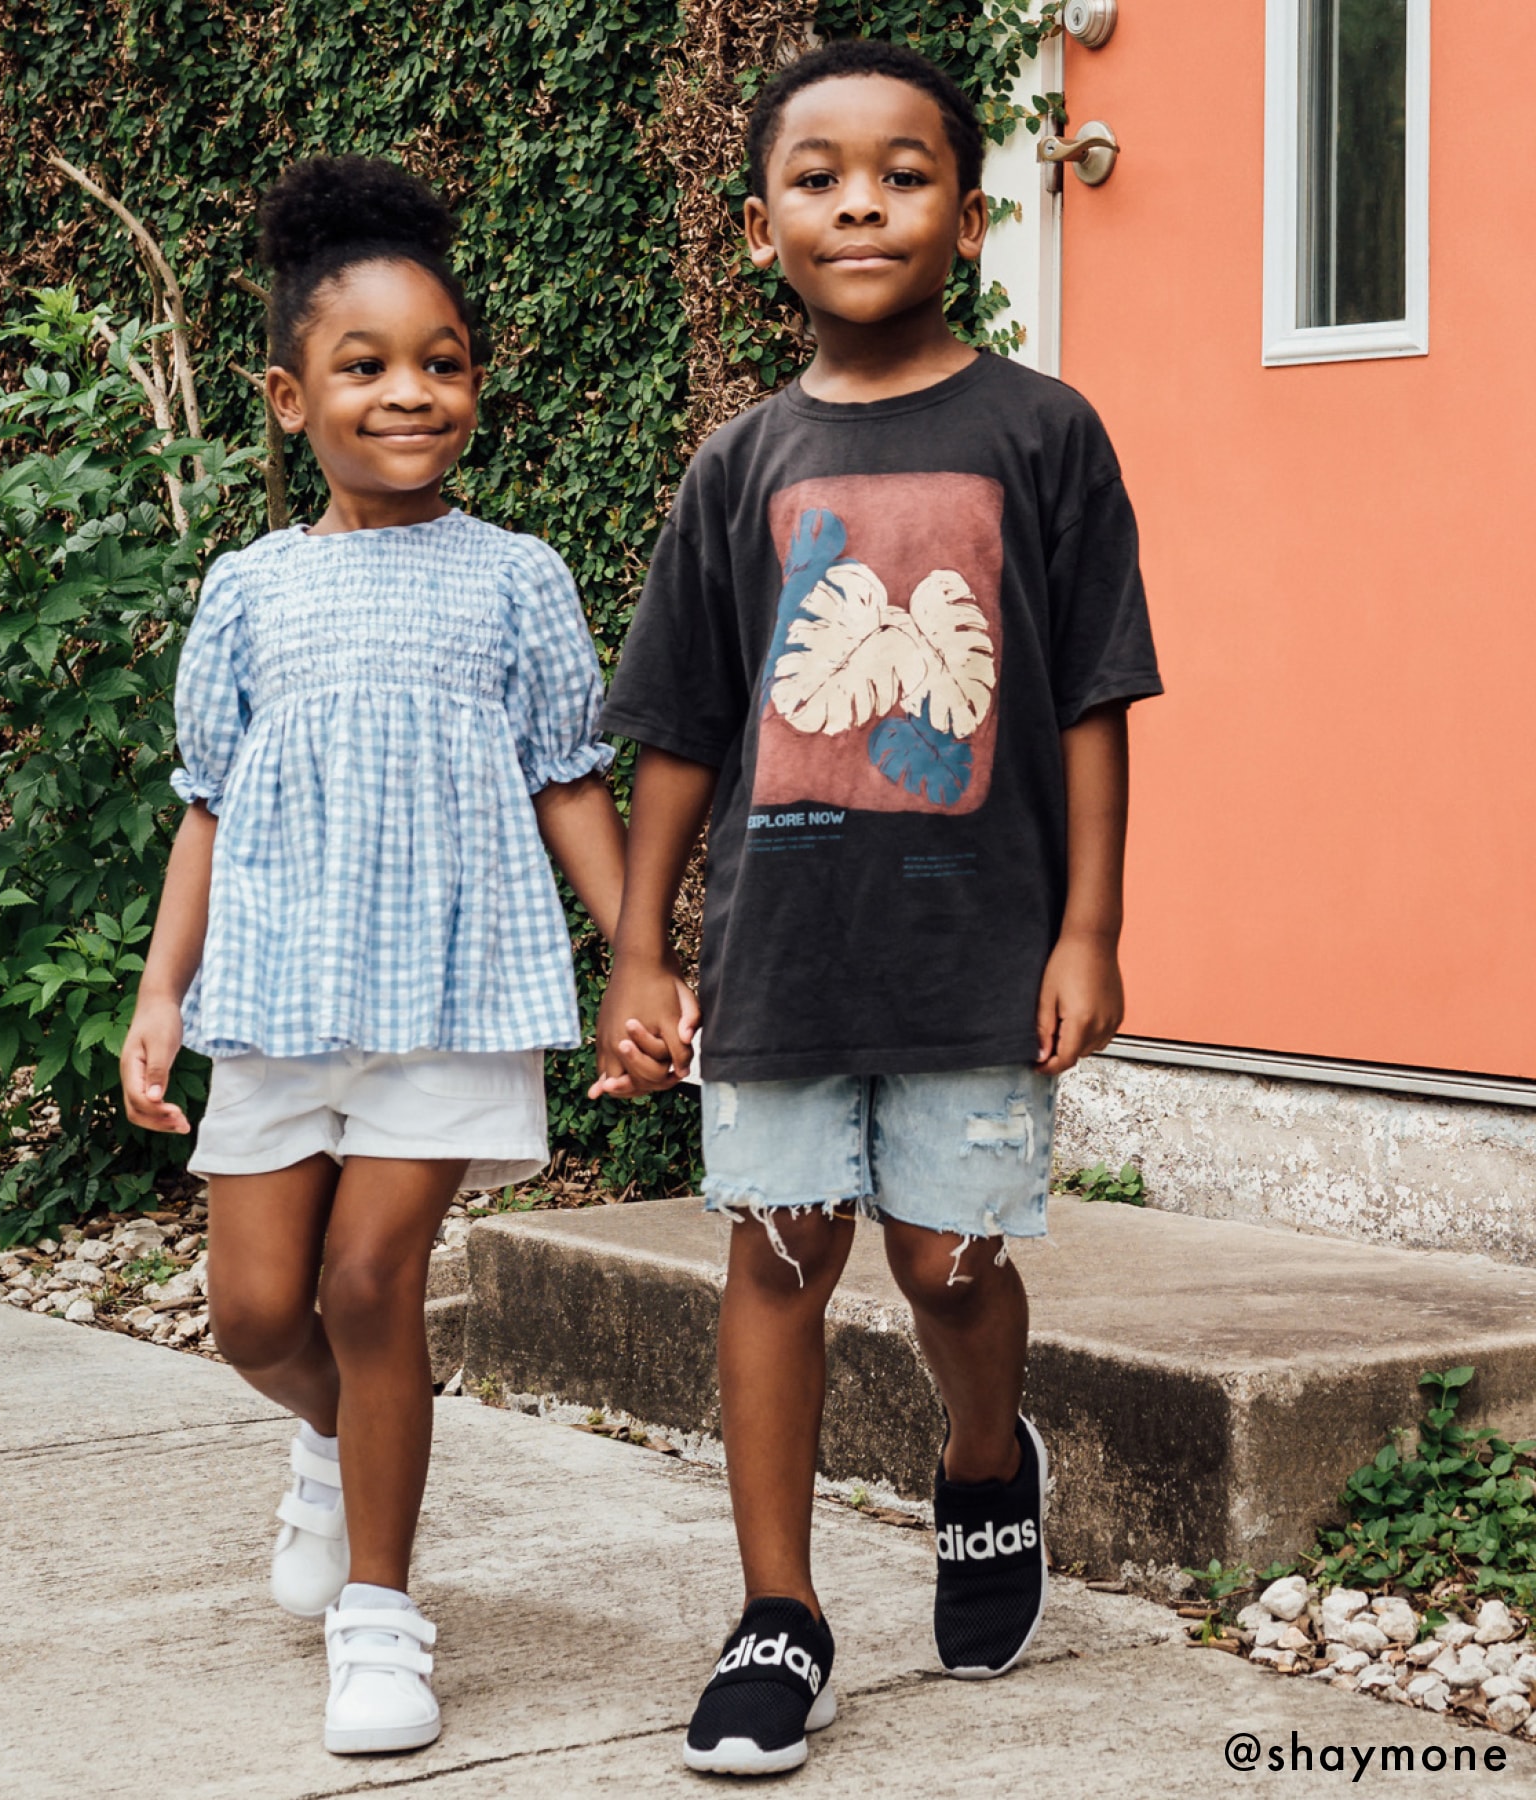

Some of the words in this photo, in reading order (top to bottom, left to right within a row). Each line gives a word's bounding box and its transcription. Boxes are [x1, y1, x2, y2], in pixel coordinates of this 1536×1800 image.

[808, 810, 846, 825] NOW
[937, 1518, 1037, 1561] didas
[708, 1631, 822, 1696] didas
